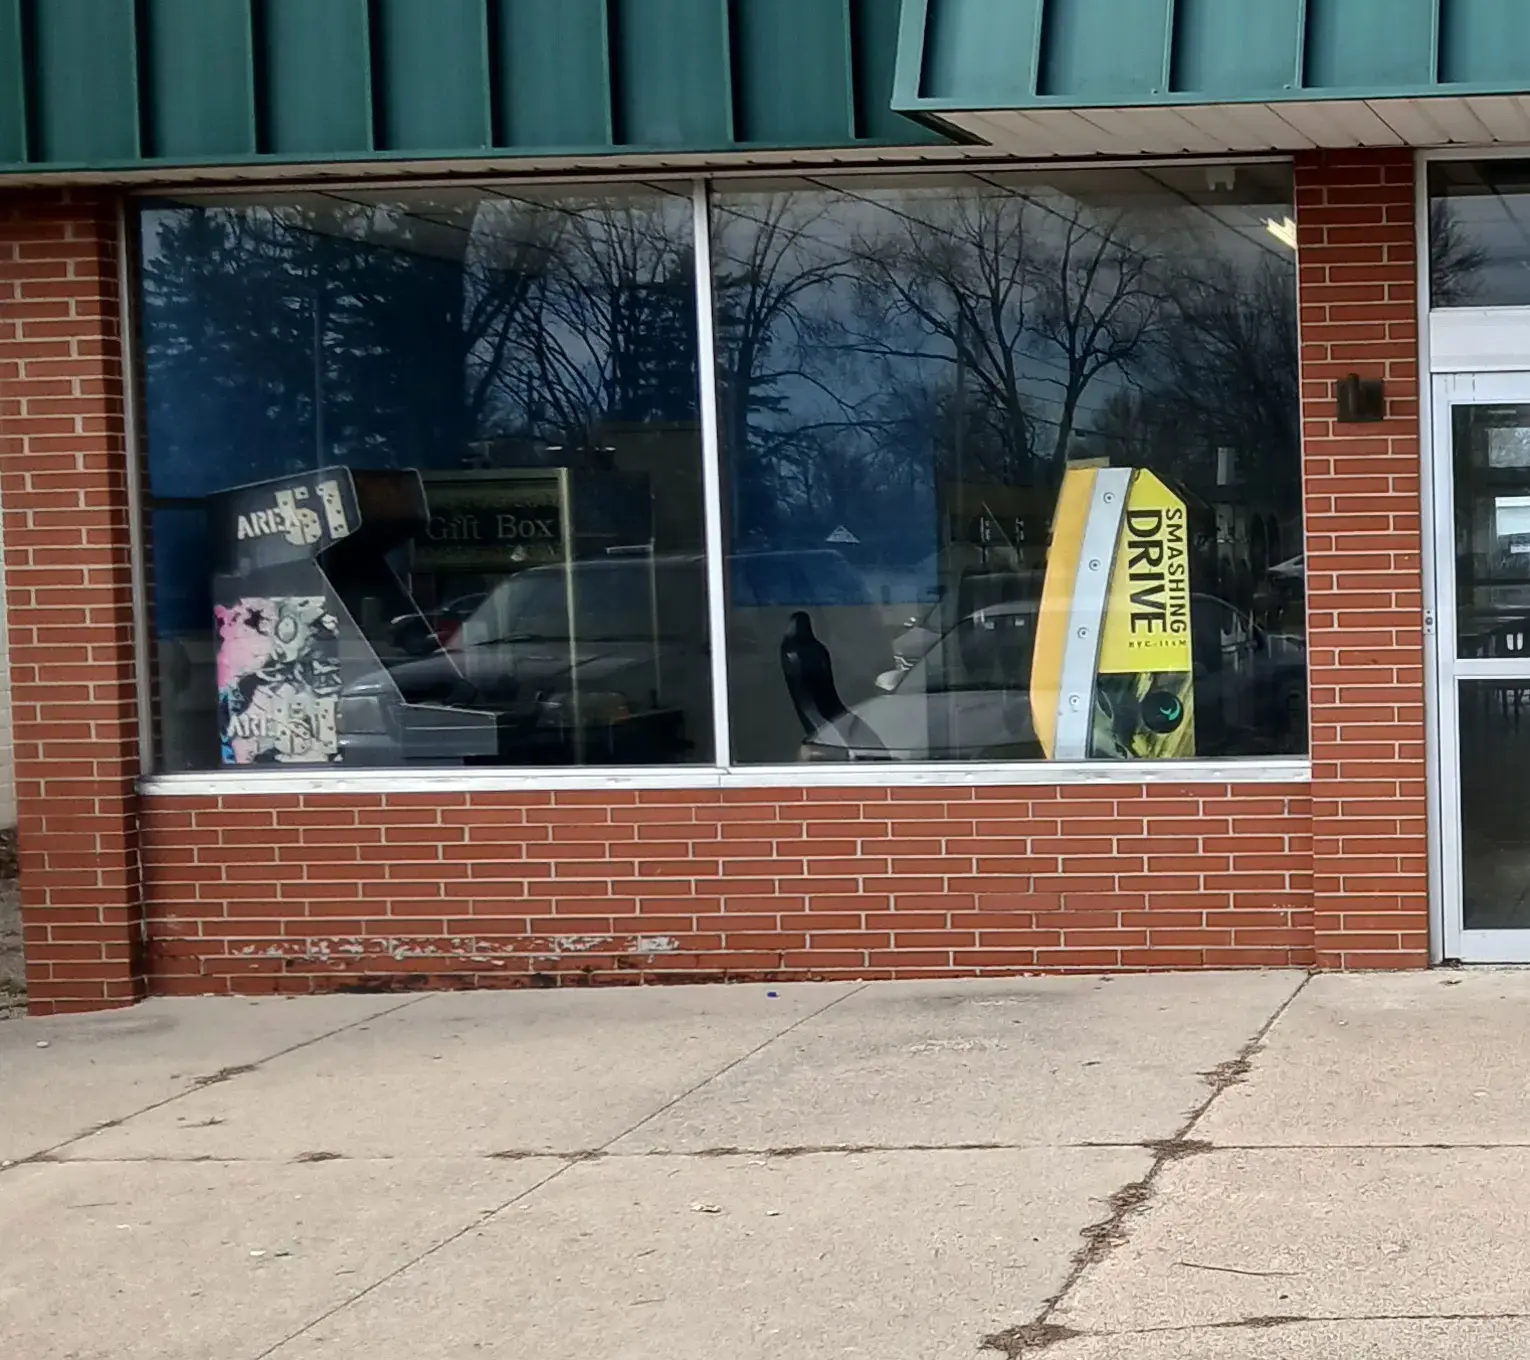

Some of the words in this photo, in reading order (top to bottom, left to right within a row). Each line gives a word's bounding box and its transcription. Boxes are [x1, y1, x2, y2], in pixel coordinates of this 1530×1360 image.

[426, 515, 482, 540] Gift
[496, 513, 555, 538] Box
[1126, 509, 1168, 634] DRIVE
[1165, 507, 1187, 634] SMASHING
